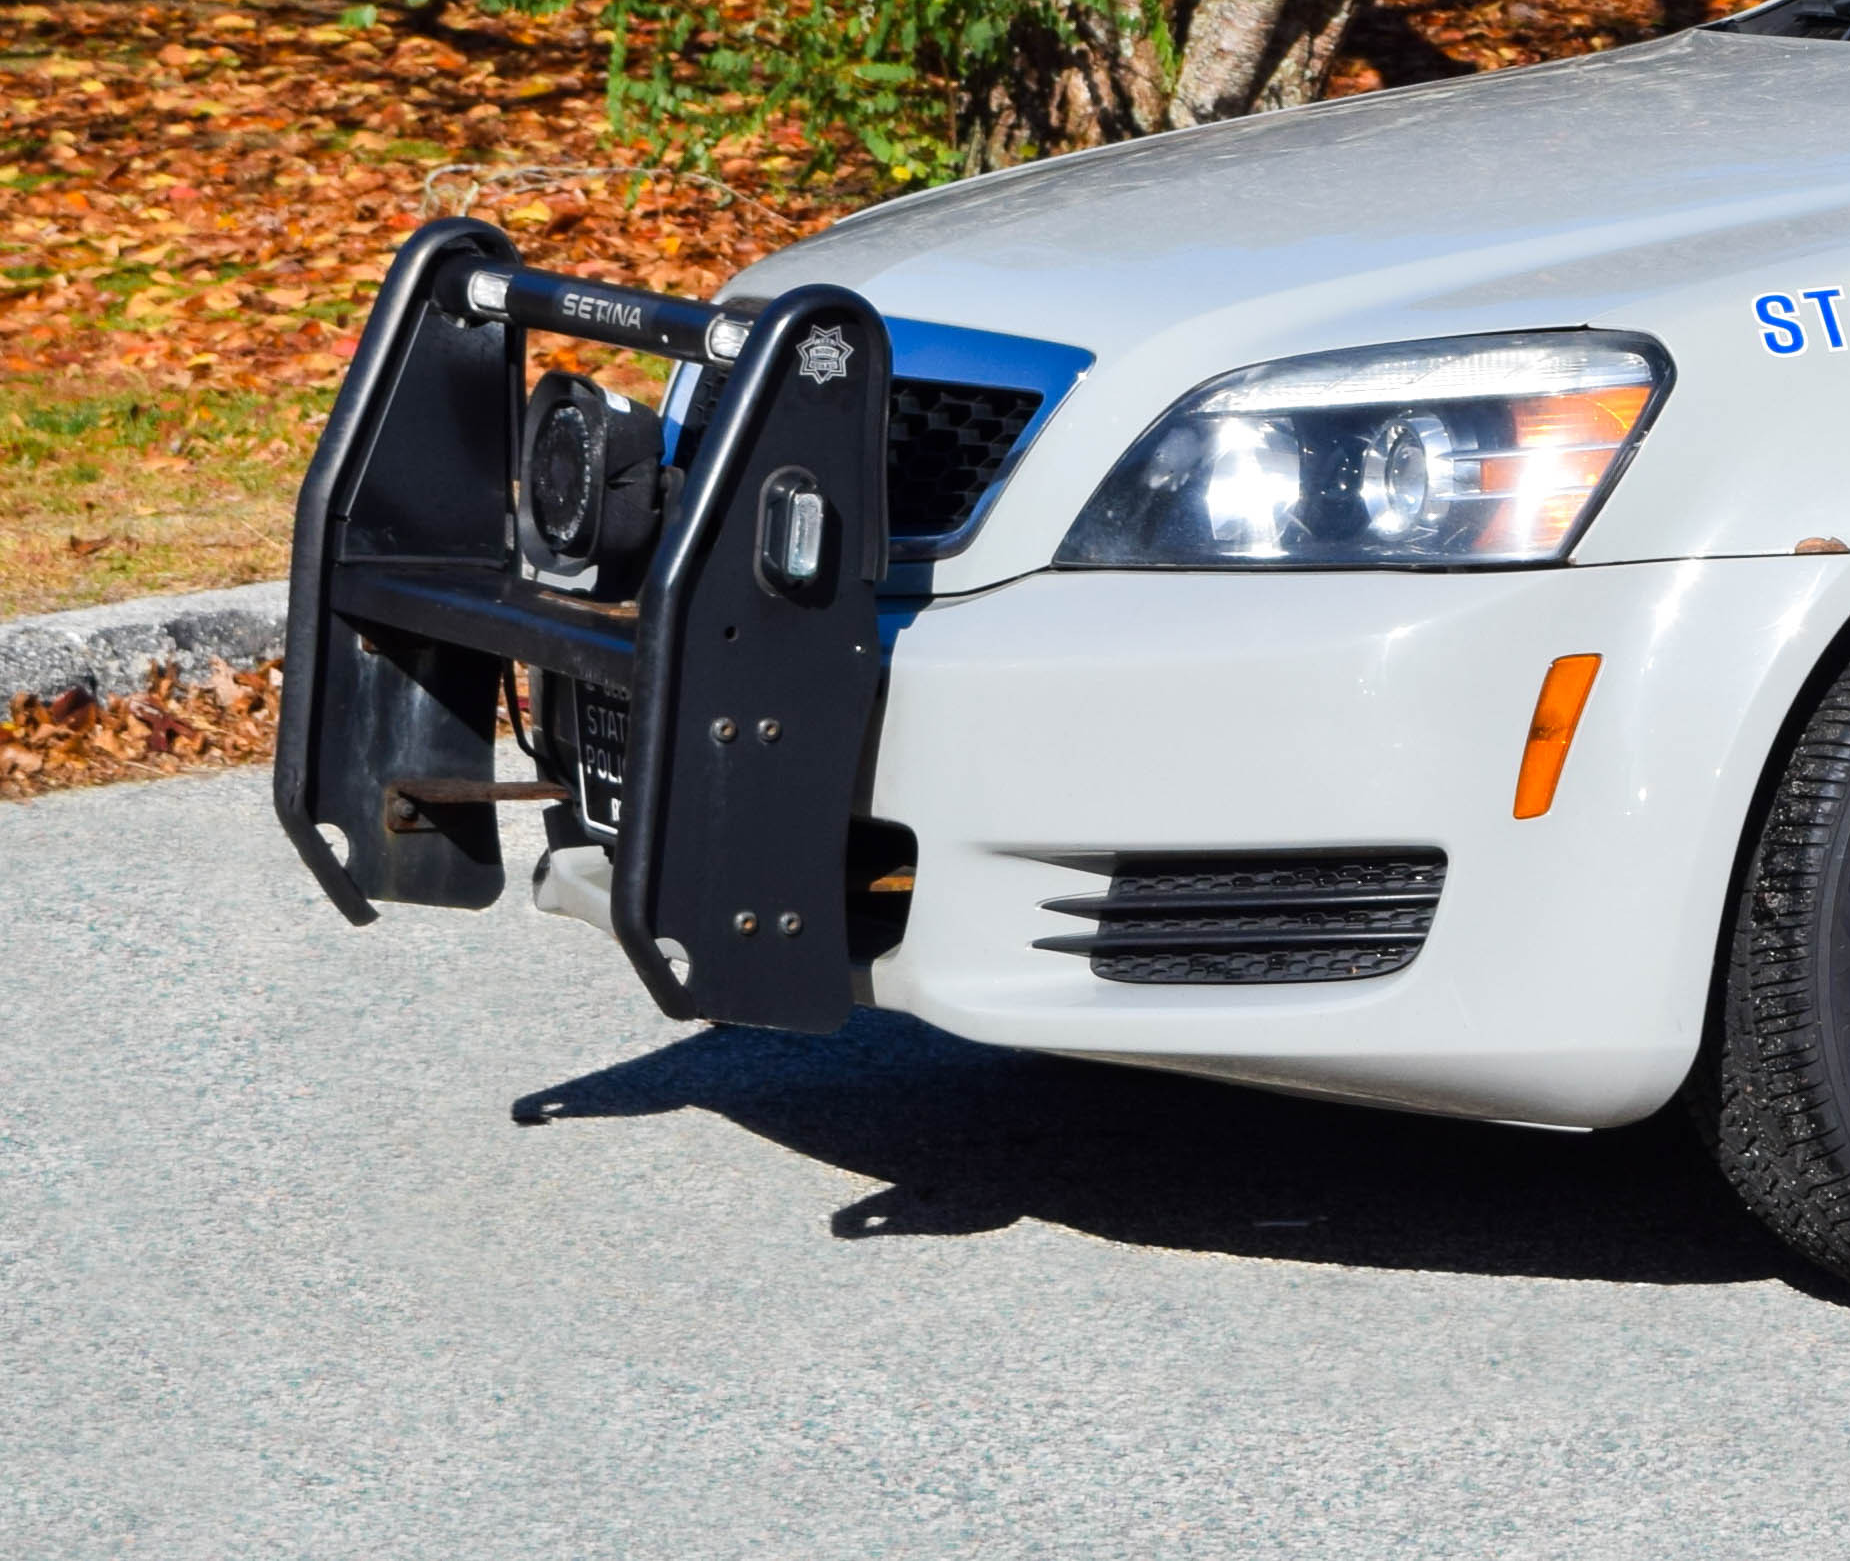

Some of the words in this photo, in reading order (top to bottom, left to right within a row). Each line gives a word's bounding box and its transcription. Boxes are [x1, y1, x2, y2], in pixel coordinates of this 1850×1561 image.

[562, 293, 642, 330] SETINA
[586, 705, 631, 743] STAT
[585, 744, 626, 784] POLI
